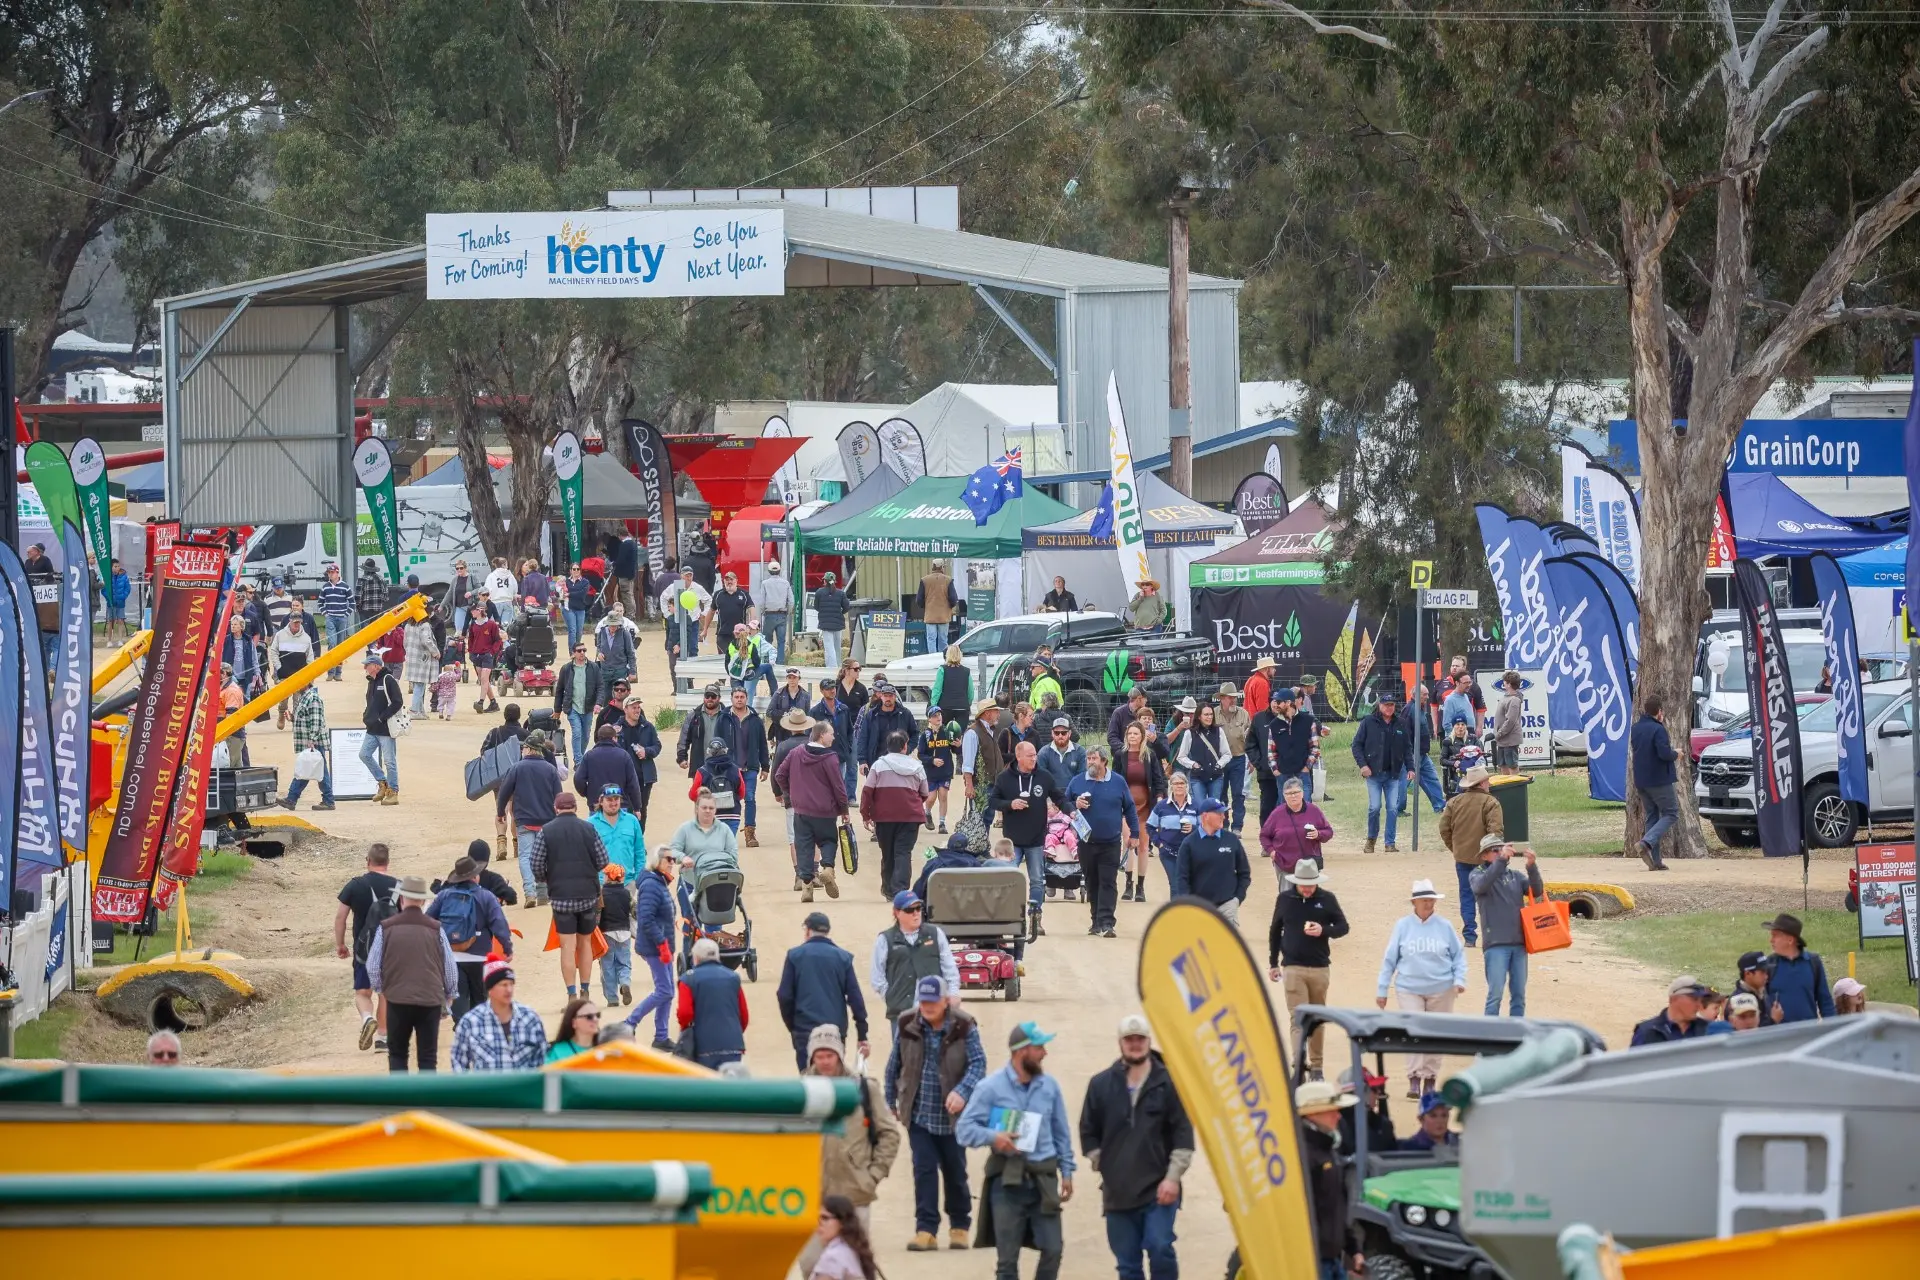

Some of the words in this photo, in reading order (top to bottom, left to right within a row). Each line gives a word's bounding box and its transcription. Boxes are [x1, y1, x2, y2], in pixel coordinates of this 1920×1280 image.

[458, 225, 511, 253] Thanks
[693, 225, 723, 250] See
[727, 221, 759, 246] You
[444, 264, 467, 286] For
[470, 252, 529, 281] Coming!
[546, 235, 666, 284] henty
[687, 258, 722, 282] Next
[726, 252, 767, 280] Year.
[548, 277, 596, 286] MACHINERY
[597, 277, 618, 286] FIELD
[619, 276, 640, 286] DAYS
[1744, 434, 1860, 472] GrainCorp
[1241, 491, 1273, 510] Best
[1148, 505, 1217, 523] BEST
[93, 506, 108, 559] TEKRON
[379, 506, 396, 558] TEKRON
[567, 501, 579, 552] TEKRON
[834, 537, 855, 552] Your
[856, 537, 893, 552] Reliable
[894, 539, 929, 554] Partner
[931, 538, 941, 553] in
[942, 539, 960, 557] Hay
[1037, 535, 1057, 546] BEST
[1057, 534, 1094, 546] LEATHER
[1154, 530, 1178, 544] BEST
[172, 557, 218, 575] STEEL
[173, 549, 221, 563] STEELE
[496, 577, 510, 589] 24
[1413, 565, 1431, 584] D
[43, 586, 53, 600] AG
[1427, 593, 1441, 605] 3rd
[1443, 594, 1457, 605] AG
[1459, 594, 1474, 606] PL.
[183, 595, 206, 656] MAXI
[873, 613, 902, 624] BEST
[1212, 617, 1283, 653] Best
[1150, 658, 1169, 669] Best
[1256, 650, 1301, 660] SYSTEMS
[163, 662, 194, 750] FEEDER
[117, 631, 173, 837] sales@steelesteel.com.au
[145, 769, 171, 832] BULK
[1859, 863, 1870, 871] UP
[1882, 862, 1900, 870] 1000
[1859, 870, 1897, 878] INTEREST
[1210, 1007, 1287, 1187] LANDACO
[1195, 1021, 1272, 1197] EQUIPMENT
